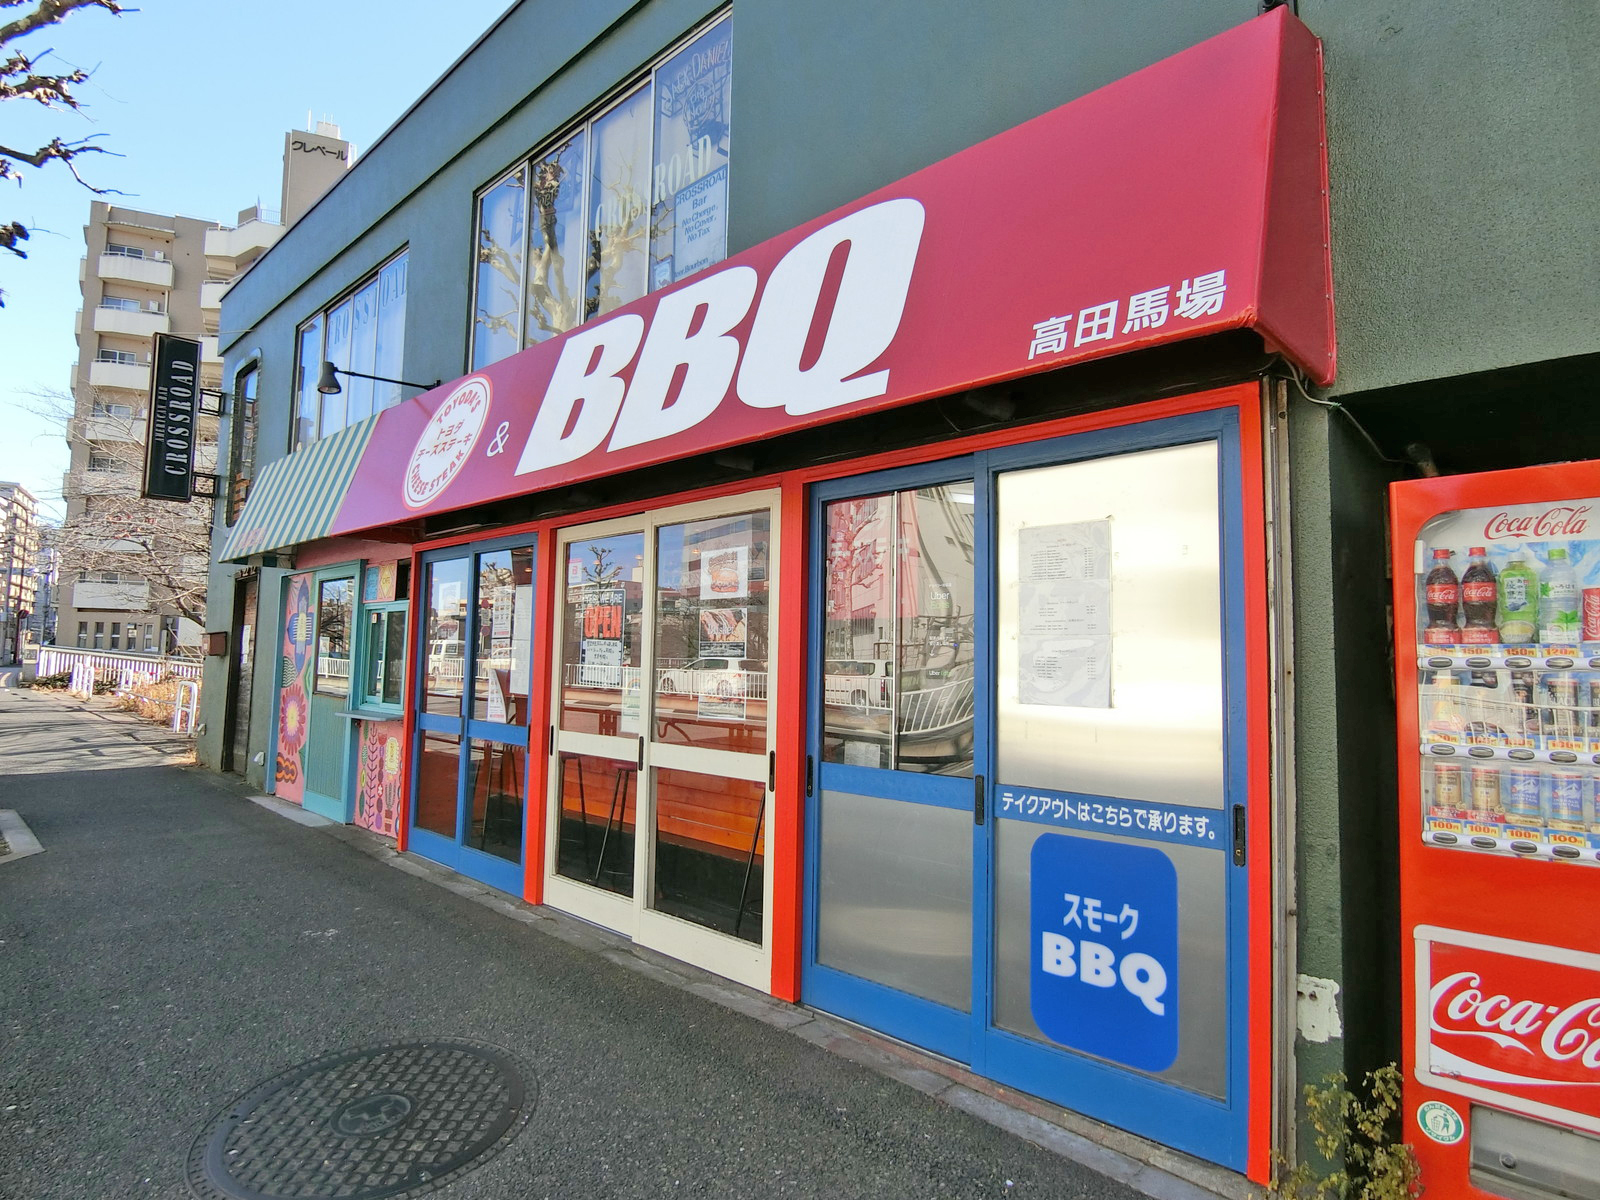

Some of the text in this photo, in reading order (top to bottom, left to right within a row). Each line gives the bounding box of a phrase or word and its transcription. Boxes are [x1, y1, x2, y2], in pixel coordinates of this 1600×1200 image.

[692, 194, 708, 210] Bar
[1028, 269, 1227, 360] 高田馬場
[514, 198, 926, 477] BBQ
[155, 386, 169, 443] AMERICAN BAR
[165, 360, 195, 476] CROSSROAD
[436, 389, 482, 425] TOYODA'S
[487, 421, 510, 457] &
[411, 450, 465, 496] CHEESE STEAK
[1483, 505, 1593, 540] Coca-Cola
[930, 591, 950, 600] Uber
[584, 604, 623, 639] OPEN
[1002, 792, 1216, 840] テイクアウトはこちらで承ります。
[1432, 821, 1459, 830] 100円
[1469, 825, 1497, 834] 100円
[1509, 829, 1539, 839] 100円
[1550, 834, 1583, 844] 100円
[1063, 892, 1139, 940] スモーク
[1042, 931, 1167, 1016] BBQ
